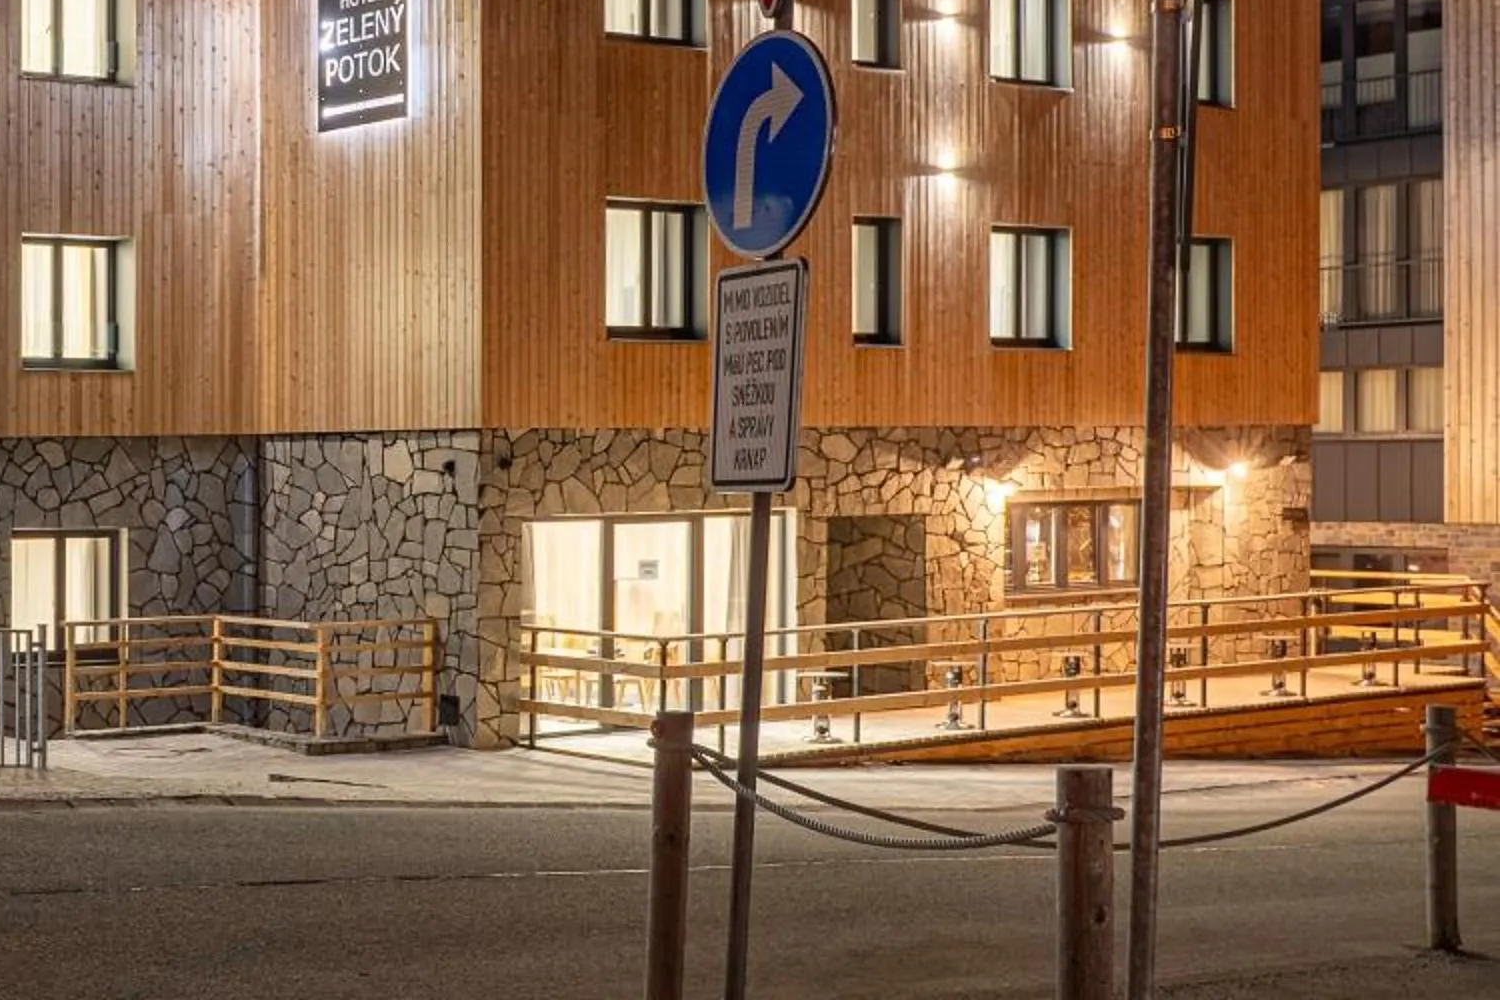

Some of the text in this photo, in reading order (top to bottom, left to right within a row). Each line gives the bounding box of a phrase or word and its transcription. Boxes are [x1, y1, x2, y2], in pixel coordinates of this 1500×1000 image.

[326, 43, 401, 87] POTOK
[726, 321, 733, 344] S
[746, 350, 764, 374] PEC
[729, 416, 736, 439] A
